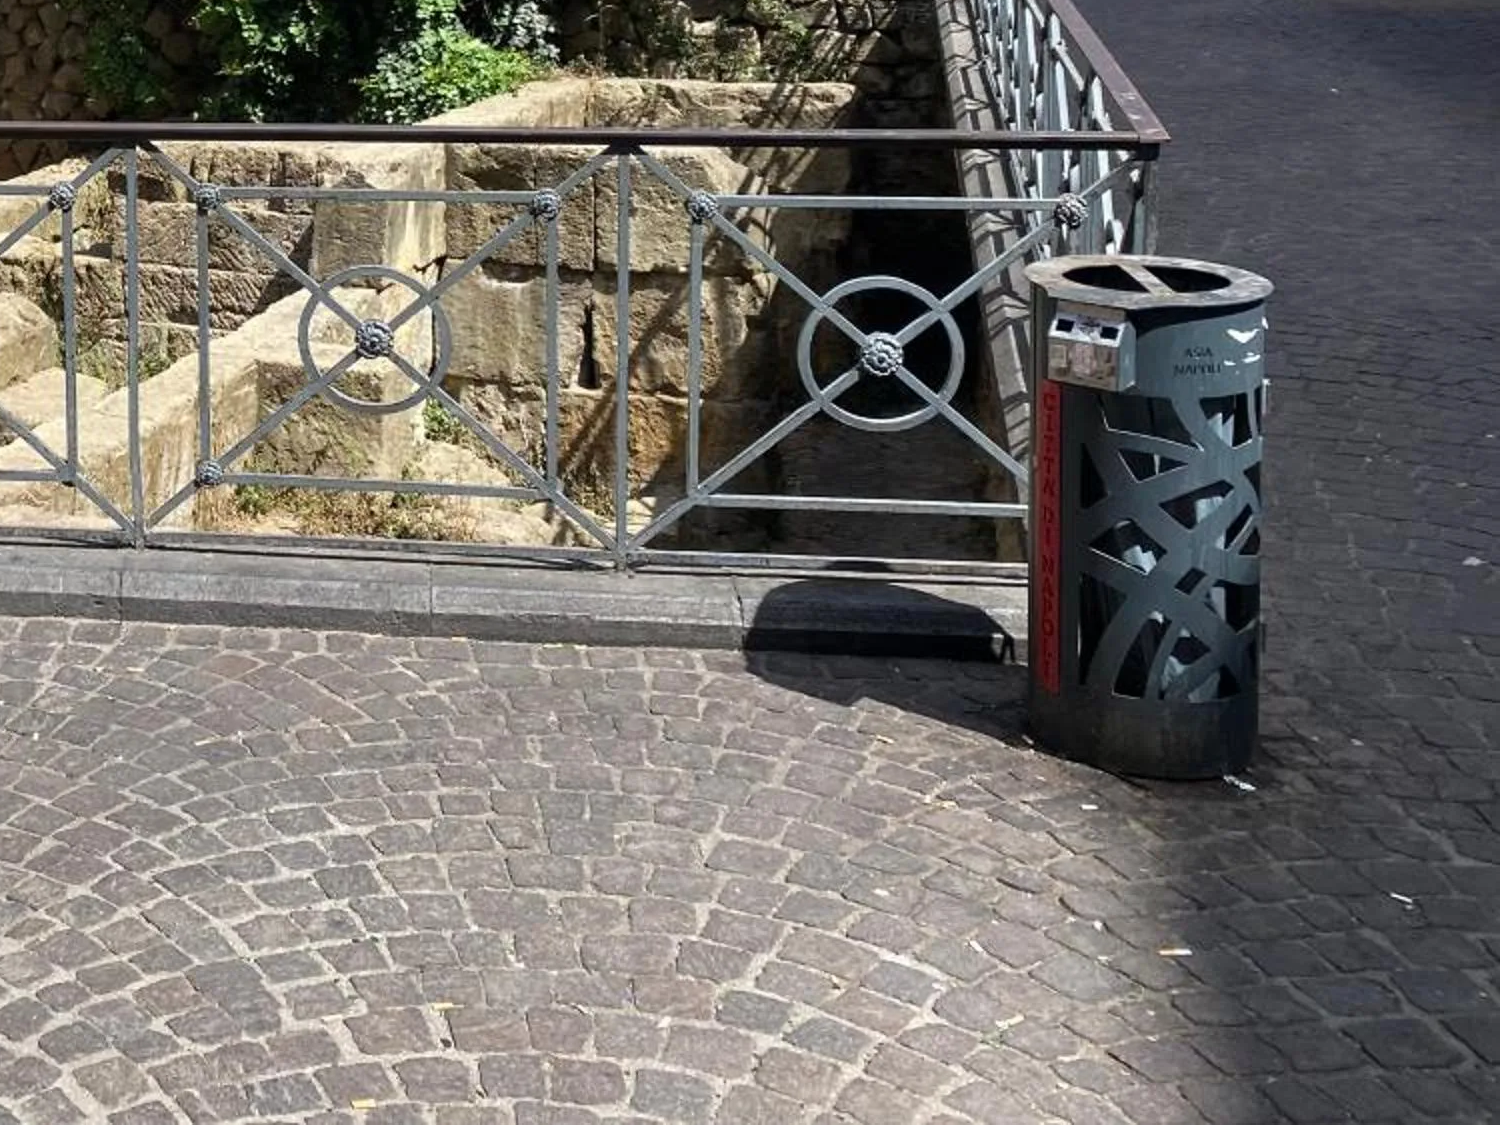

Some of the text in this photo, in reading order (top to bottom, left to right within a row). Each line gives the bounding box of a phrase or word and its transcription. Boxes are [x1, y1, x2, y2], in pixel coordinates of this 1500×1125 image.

[1184, 346, 1213, 358] ASIA
[1173, 362, 1221, 375] NAPOLI
[1042, 554, 1055, 678] NAPOLI
